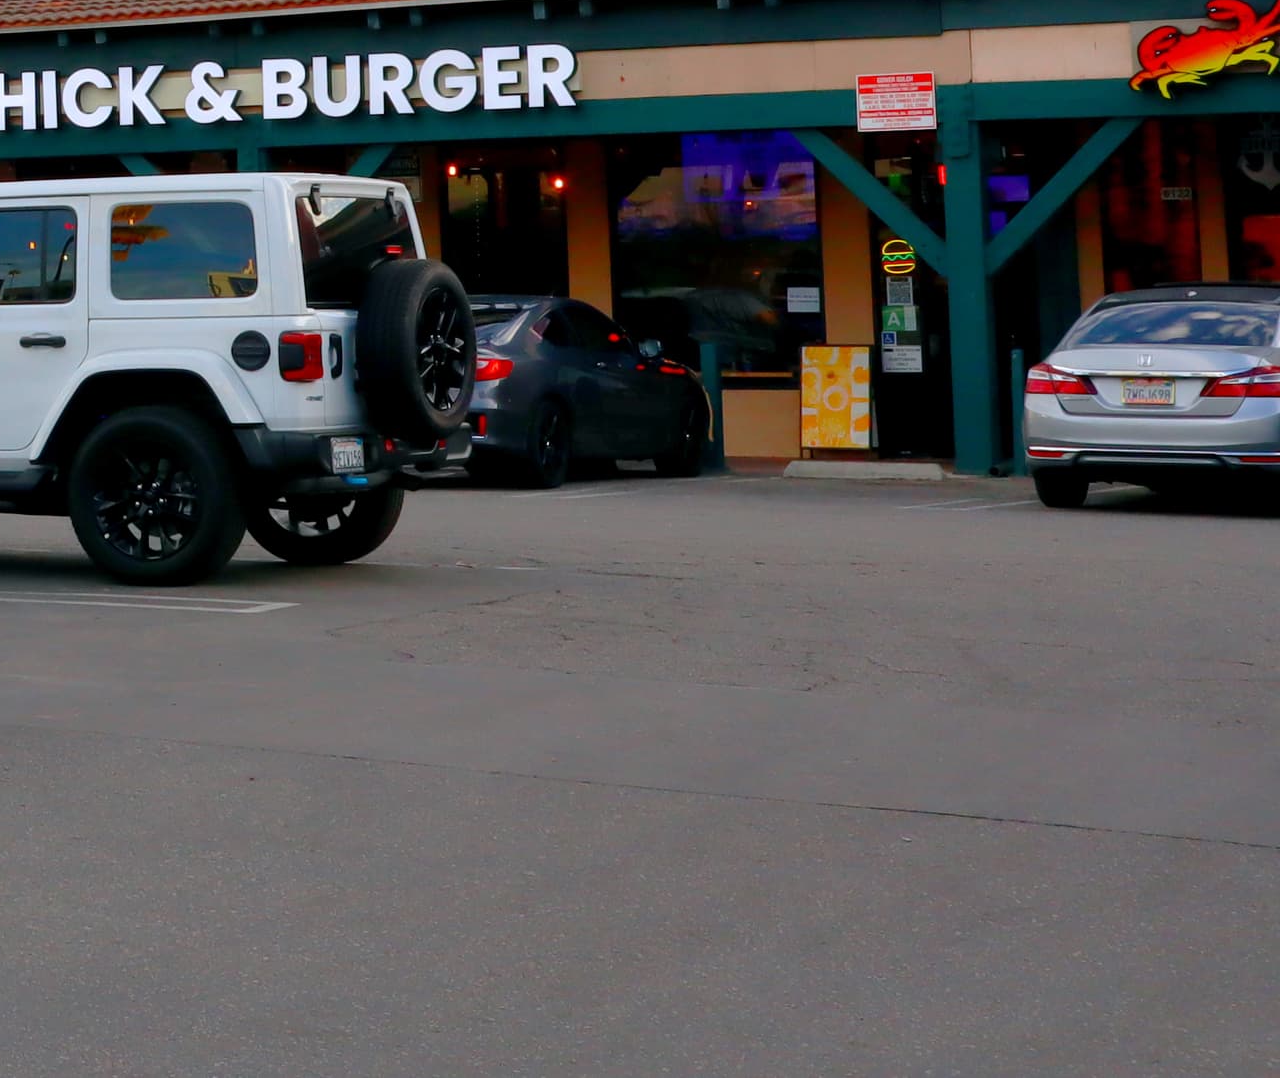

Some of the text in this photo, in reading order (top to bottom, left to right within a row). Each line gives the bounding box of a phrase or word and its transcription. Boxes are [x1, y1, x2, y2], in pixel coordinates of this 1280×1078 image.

[185, 60, 243, 123] &
[261, 43, 579, 121] BURGER
[887, 312, 901, 326] A
